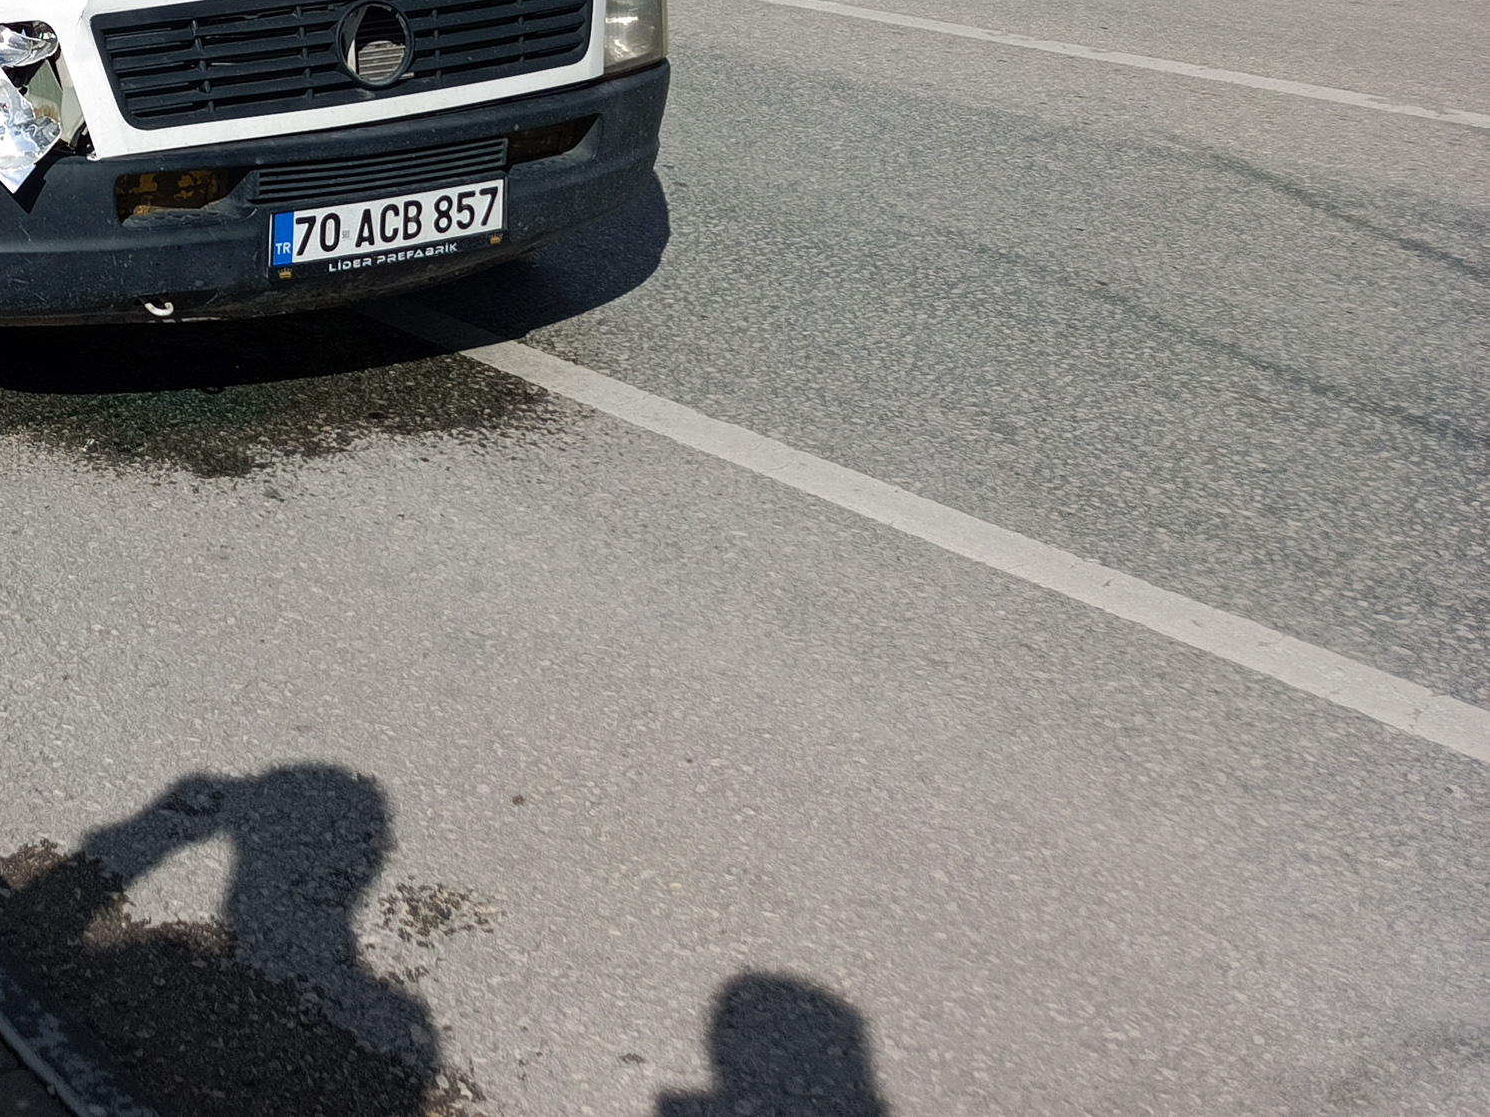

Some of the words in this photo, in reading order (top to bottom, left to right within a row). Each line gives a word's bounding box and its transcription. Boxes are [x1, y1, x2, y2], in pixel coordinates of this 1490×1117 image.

[295, 212, 341, 256] 70
[355, 200, 423, 248] ACB
[433, 186, 499, 234] 857
[275, 241, 291, 255] TR
